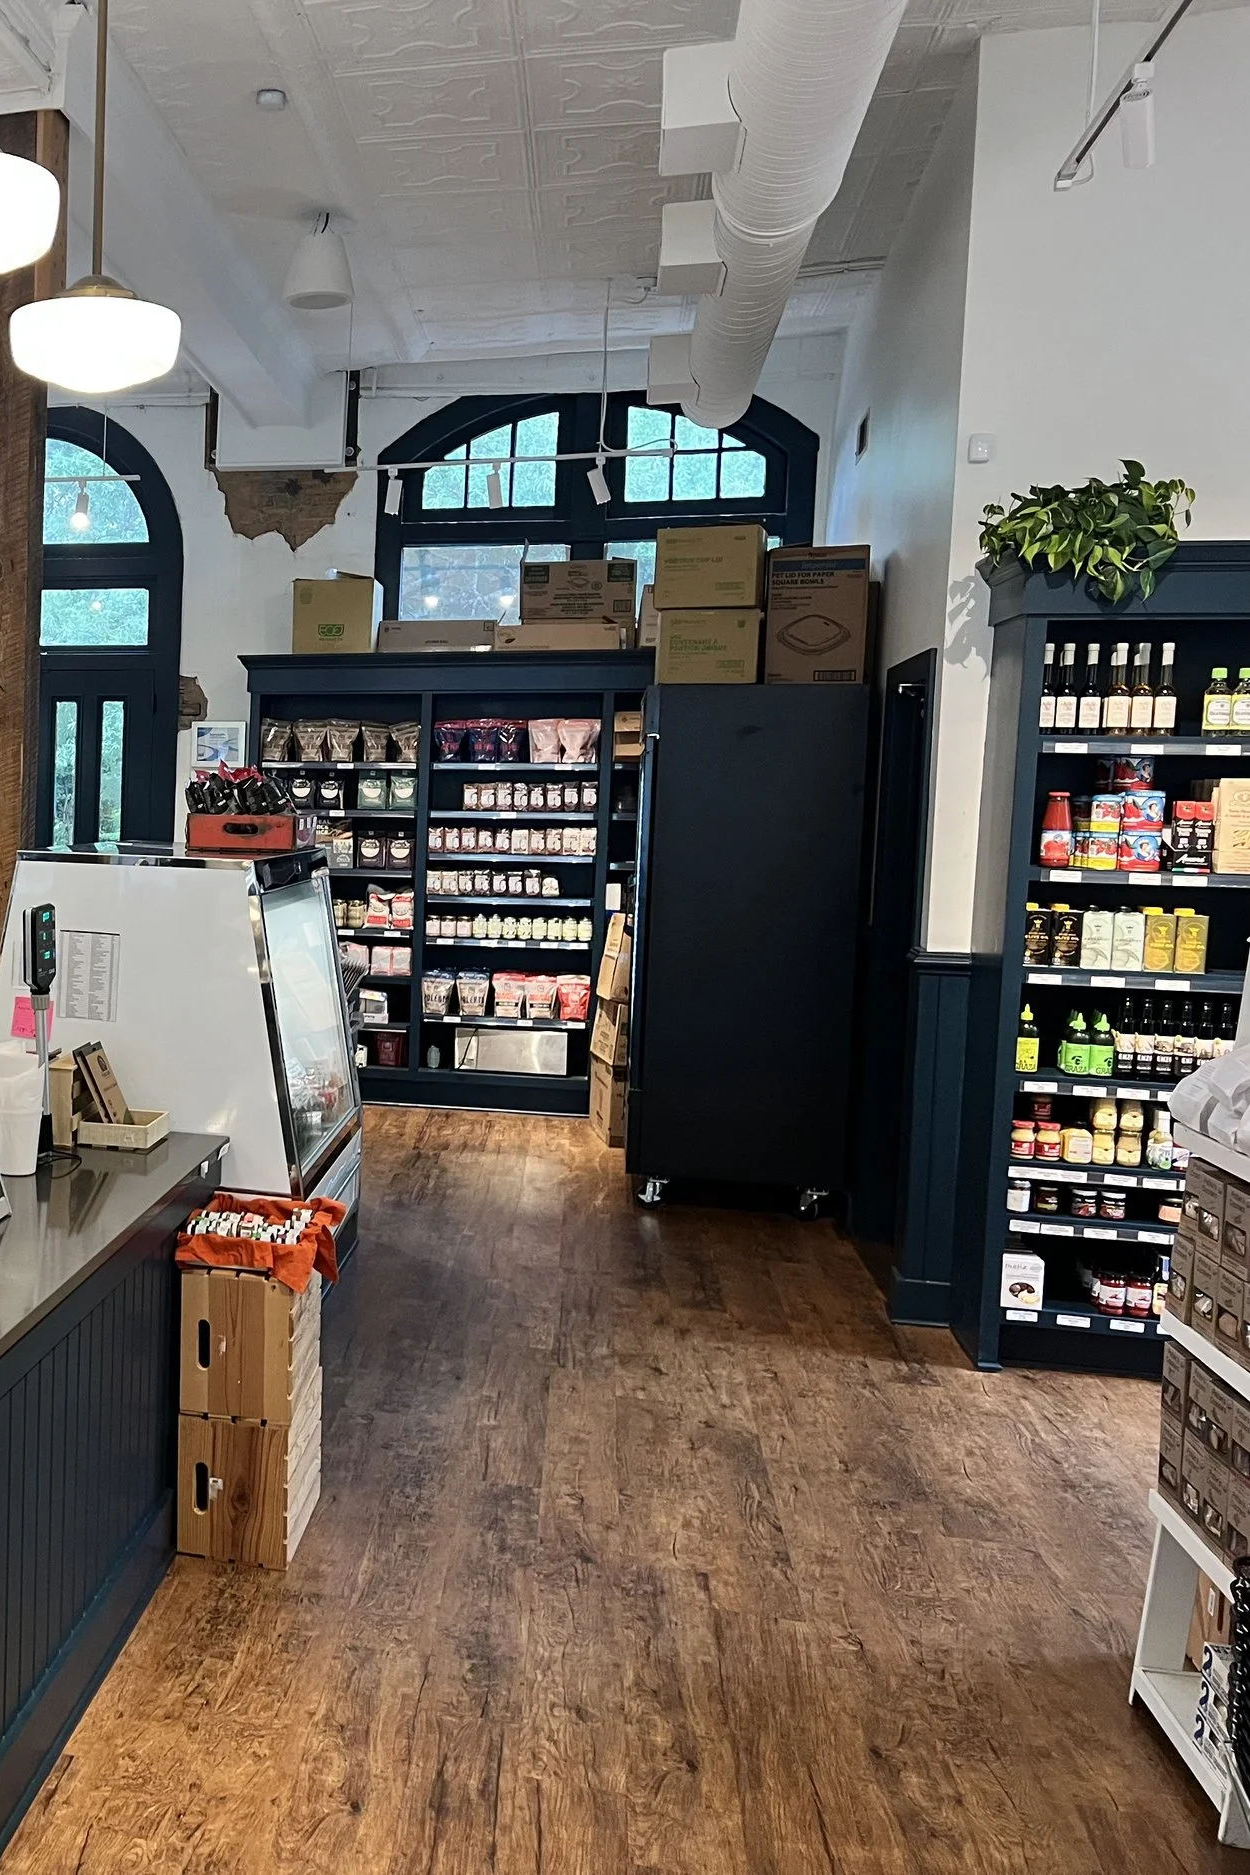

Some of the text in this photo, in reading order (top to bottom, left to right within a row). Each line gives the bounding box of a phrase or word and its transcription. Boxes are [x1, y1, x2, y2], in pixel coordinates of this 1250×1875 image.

[1015, 1062, 1037, 1070] GRAZA
[1065, 1064, 1087, 1073] GRAZA
[1095, 1067, 1112, 1075] GRA
